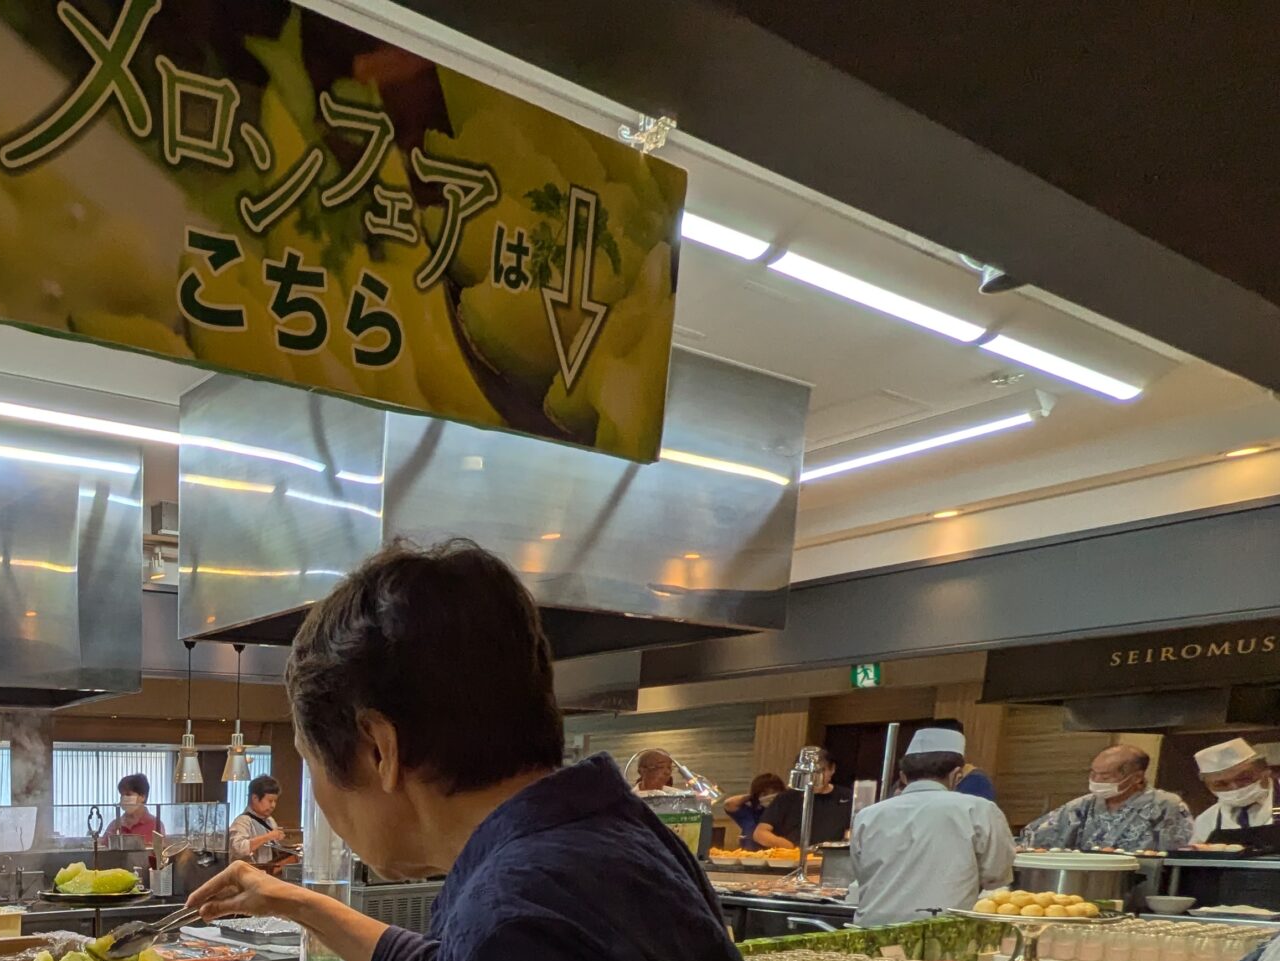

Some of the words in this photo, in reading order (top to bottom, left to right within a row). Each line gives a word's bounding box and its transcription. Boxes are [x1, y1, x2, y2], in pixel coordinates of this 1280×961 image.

[177, 224, 405, 370] こちら
[1109, 635, 1277, 667] SEIROMUS
